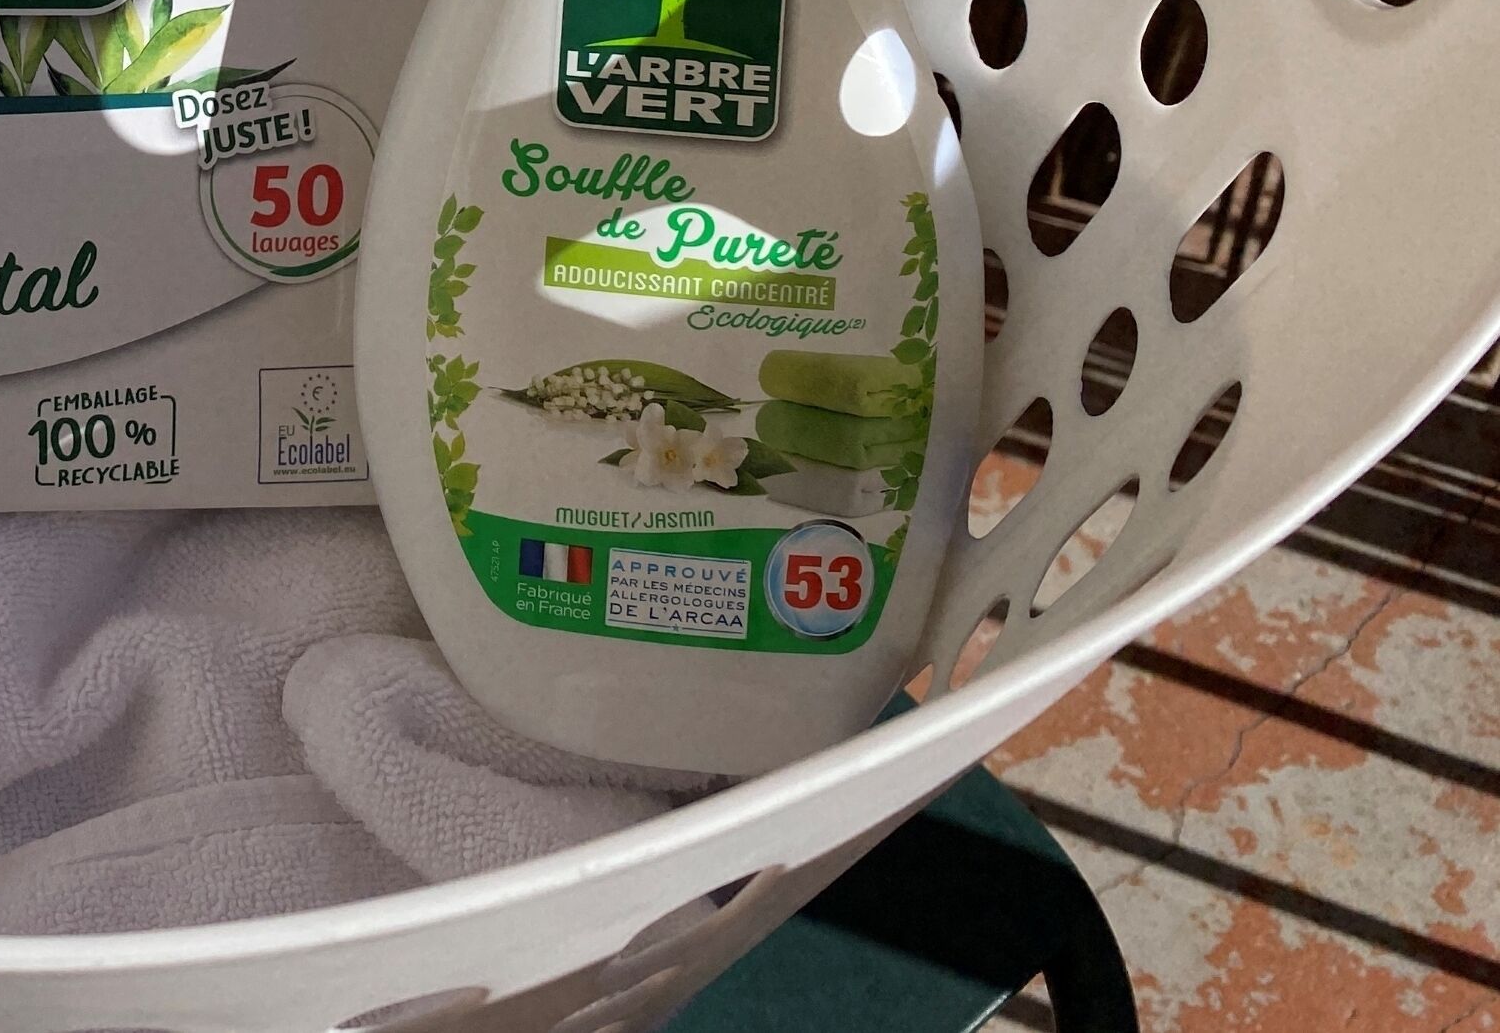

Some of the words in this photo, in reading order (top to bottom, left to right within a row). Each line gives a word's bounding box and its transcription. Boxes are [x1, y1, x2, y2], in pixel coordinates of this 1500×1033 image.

[566, 50, 771, 91] L'ARBRE
[178, 87, 267, 122] Dosez
[566, 80, 769, 127] VERT
[202, 113, 293, 163] JUSTE
[502, 138, 696, 203] Souffle
[250, 164, 344, 227] 50
[252, 232, 339, 257] lavages
[597, 207, 646, 240] de
[657, 207, 844, 270] Pureté
[553, 264, 702, 297] ADOUCISSANT
[711, 278, 829, 305] CONCENTRÉ
[54, 386, 158, 411] EMBALLAGE
[28, 414, 115, 465] 100
[125, 420, 156, 446] %
[279, 425, 295, 436] EU
[278, 434, 350, 465] Ecolabel
[58, 459, 179, 487] RECYCLABLE
[274, 466, 356, 475] www.ecolabel.eu
[555, 507, 714, 528] MUGUET/JASMIN
[612, 560, 747, 583] APPROUVÉ
[783, 554, 863, 610] 53
[517, 583, 591, 605] Fabriqué
[610, 590, 745, 610] ALLERGOLOGUES
[611, 577, 638, 587] PAR
[643, 580, 668, 590] LES
[674, 583, 746, 598] MÉDECINS
[516, 600, 534, 611] en
[539, 601, 590, 620] France
[610, 603, 638, 617] DE
[650, 607, 743, 627] L'ARCAA
